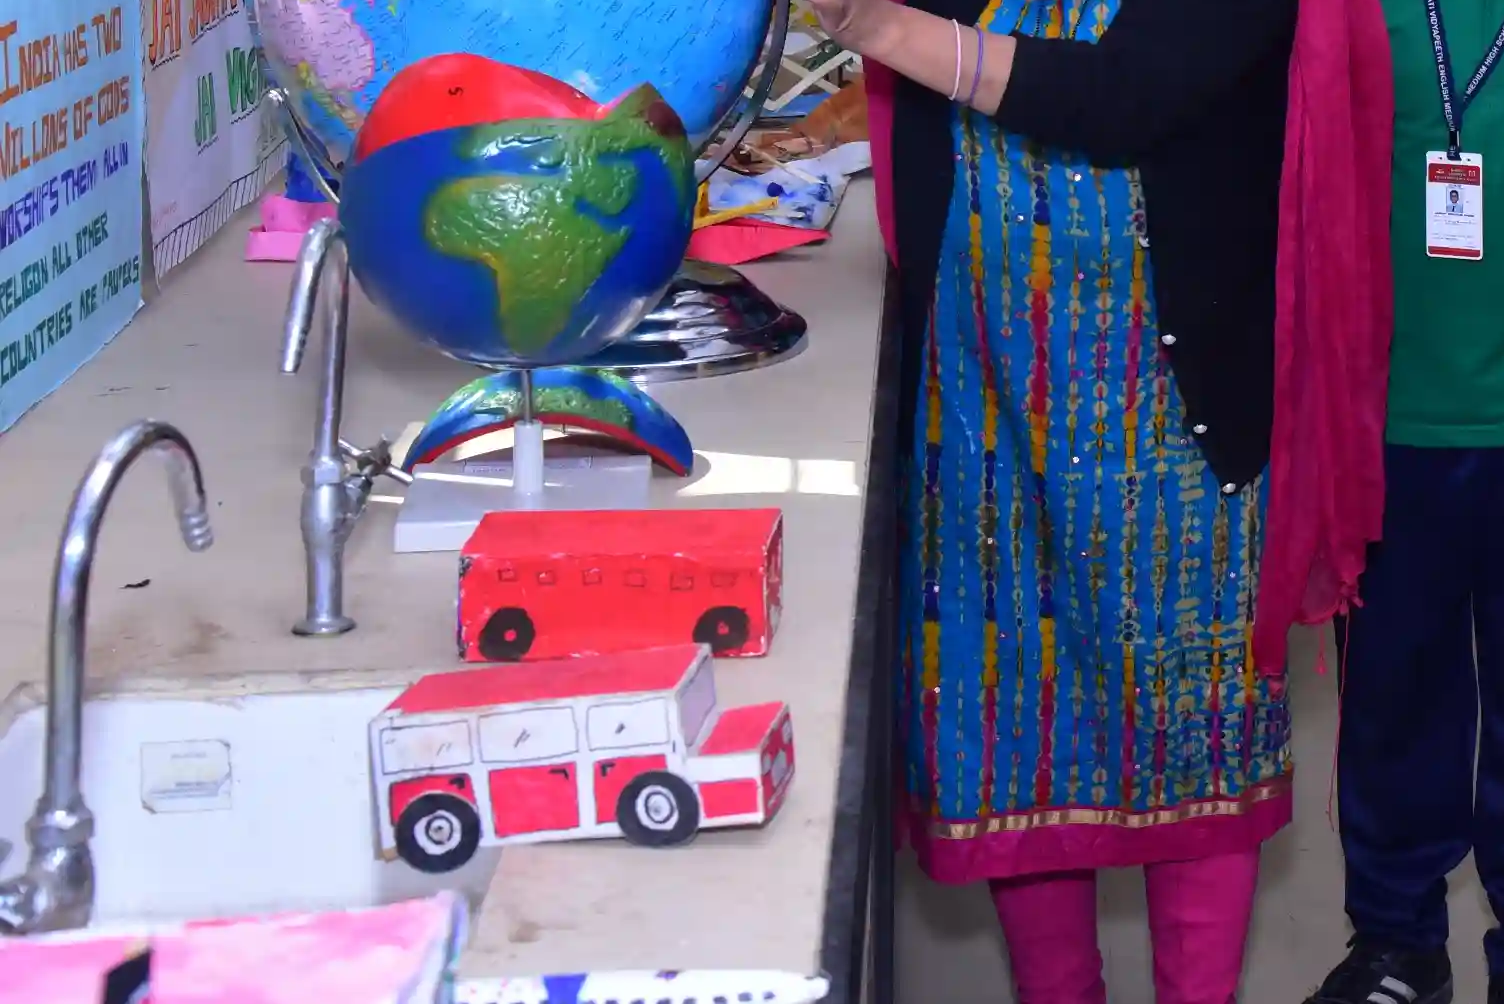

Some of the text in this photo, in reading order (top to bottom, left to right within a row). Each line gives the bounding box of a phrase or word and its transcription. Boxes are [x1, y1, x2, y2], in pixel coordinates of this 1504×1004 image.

[0, 6, 122, 106] INDIA HAS TWO
[1428, 10, 1445, 63] VIDYAPEETH
[1438, 63, 1450, 102] ENGLISH
[1466, 62, 1488, 95] MEDIUM
[1484, 44, 1500, 66] HIGH
[73, 95, 93, 141] OF
[194, 71, 217, 147] JAI
[61, 159, 97, 206] THEM
[103, 146, 119, 179] ALL
[52, 241, 71, 280] ALL
[76, 210, 109, 262] OTHER
[0, 301, 73, 388] COUNTRIES
[79, 283, 98, 323] ARE
